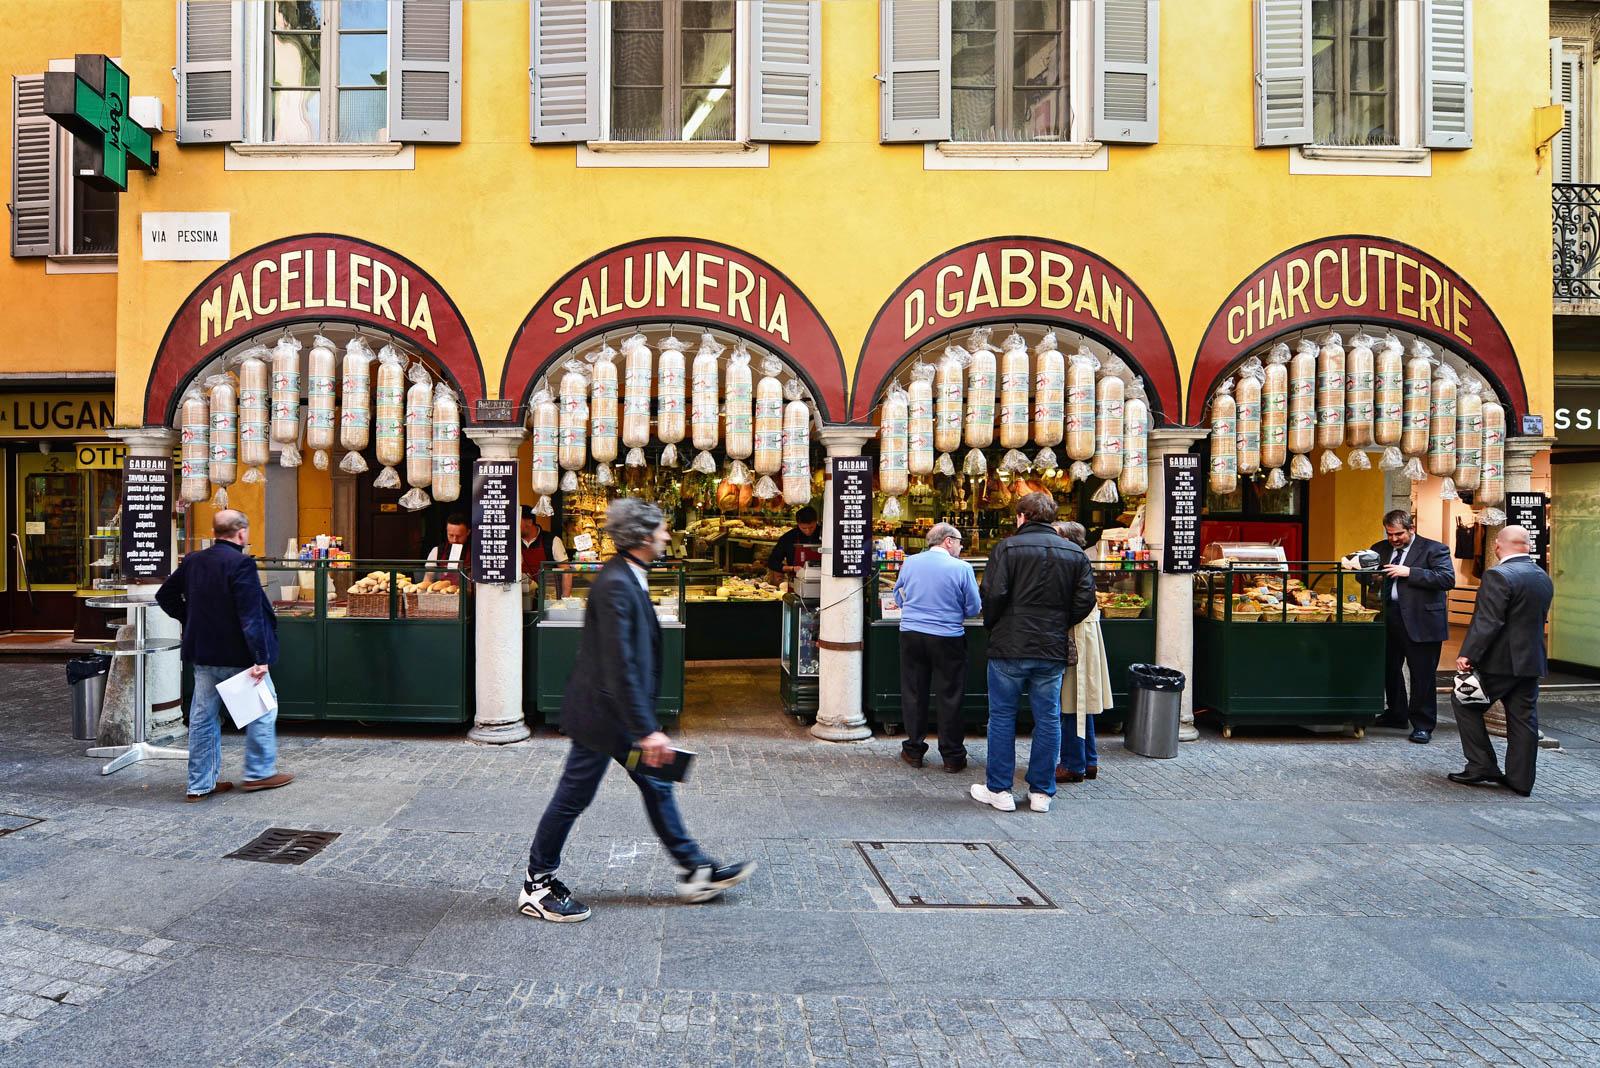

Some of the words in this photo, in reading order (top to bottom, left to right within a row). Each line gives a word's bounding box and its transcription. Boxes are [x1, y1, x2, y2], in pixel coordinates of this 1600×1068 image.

[152, 230, 167, 243] VIA
[177, 230, 219, 243] PESSINA
[199, 248, 438, 347] MACELLERIA
[552, 250, 791, 345] SALUMERIA
[1226, 246, 1473, 346] CHARCUTERIE
[129, 459, 167, 469] GABBANI
[478, 465, 513, 474] GABBANI
[128, 474, 148, 482] TAVOLA
[127, 485, 142, 493] pasta
[150, 485, 165, 493] giorno
[1511, 495, 1541, 504] GABBANI
[145, 541, 155, 549] dog
